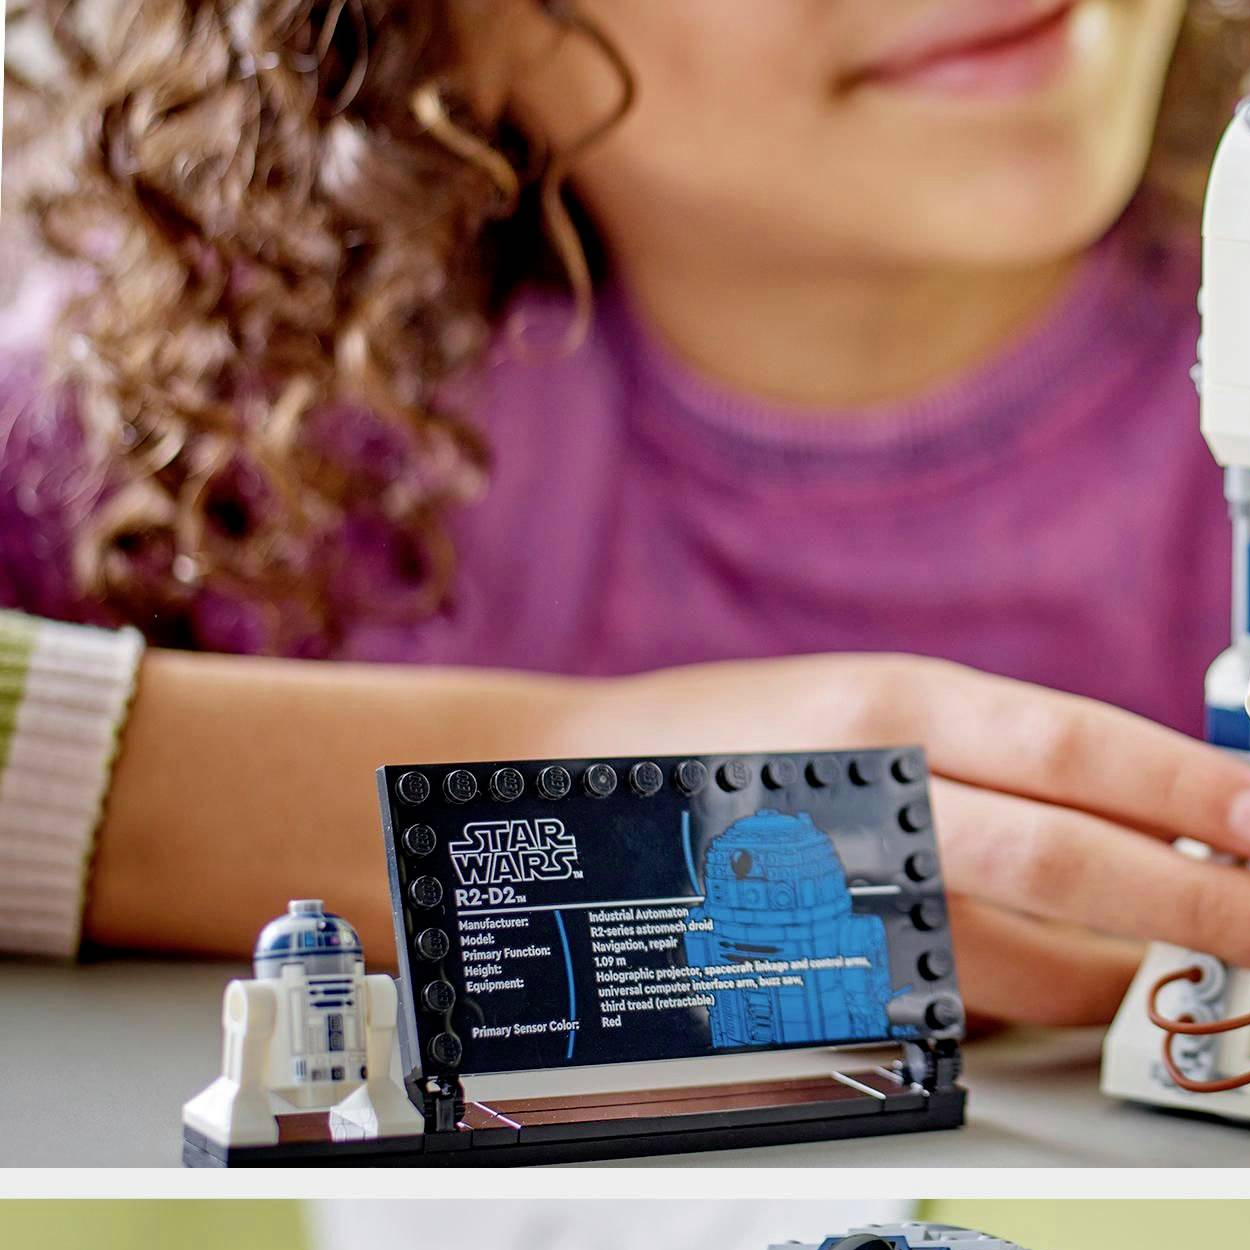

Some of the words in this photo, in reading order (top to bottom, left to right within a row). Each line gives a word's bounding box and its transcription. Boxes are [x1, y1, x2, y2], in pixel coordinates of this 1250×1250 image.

[449, 818, 576, 853] STAR
[458, 917, 529, 931] Manufacturer:
[589, 910, 634, 924] Industrial
[636, 907, 689, 921] Automaton
[590, 924, 635, 938] R2-series
[636, 922, 687, 936] astromech
[689, 919, 714, 932] droid
[460, 934, 495, 946] Model:
[592, 939, 648, 954] Navigation,
[649, 936, 678, 951] repair
[462, 950, 502, 963] Primary
[504, 946, 551, 959] Function:
[594, 956, 615, 967] 1.09
[616, 957, 626, 966] m
[464, 965, 502, 979] Height:
[596, 969, 654, 983] Holographic
[656, 966, 702, 981] projector,
[704, 963, 753, 977] spacecraft
[754, 960, 789, 974] linkage
[790, 958, 809, 970] and
[810, 956, 843, 969] control
[844, 956, 872, 968] arms,
[466, 978, 524, 993] Equipment:
[598, 984, 643, 997] universal
[644, 980, 691, 995] computer
[692, 978, 735, 992] interface
[736, 978, 758, 990] arm,
[759, 975, 780, 987] buzz
[782, 974, 804, 986] saw,
[601, 1000, 626, 1013] third
[627, 998, 653, 1011] tread
[655, 994, 715, 1010] (retractable)
[472, 1026, 512, 1040] Primary
[514, 1022, 547, 1035] Sensor
[549, 1019, 580, 1032] Color:
[602, 1016, 622, 1028] Red
